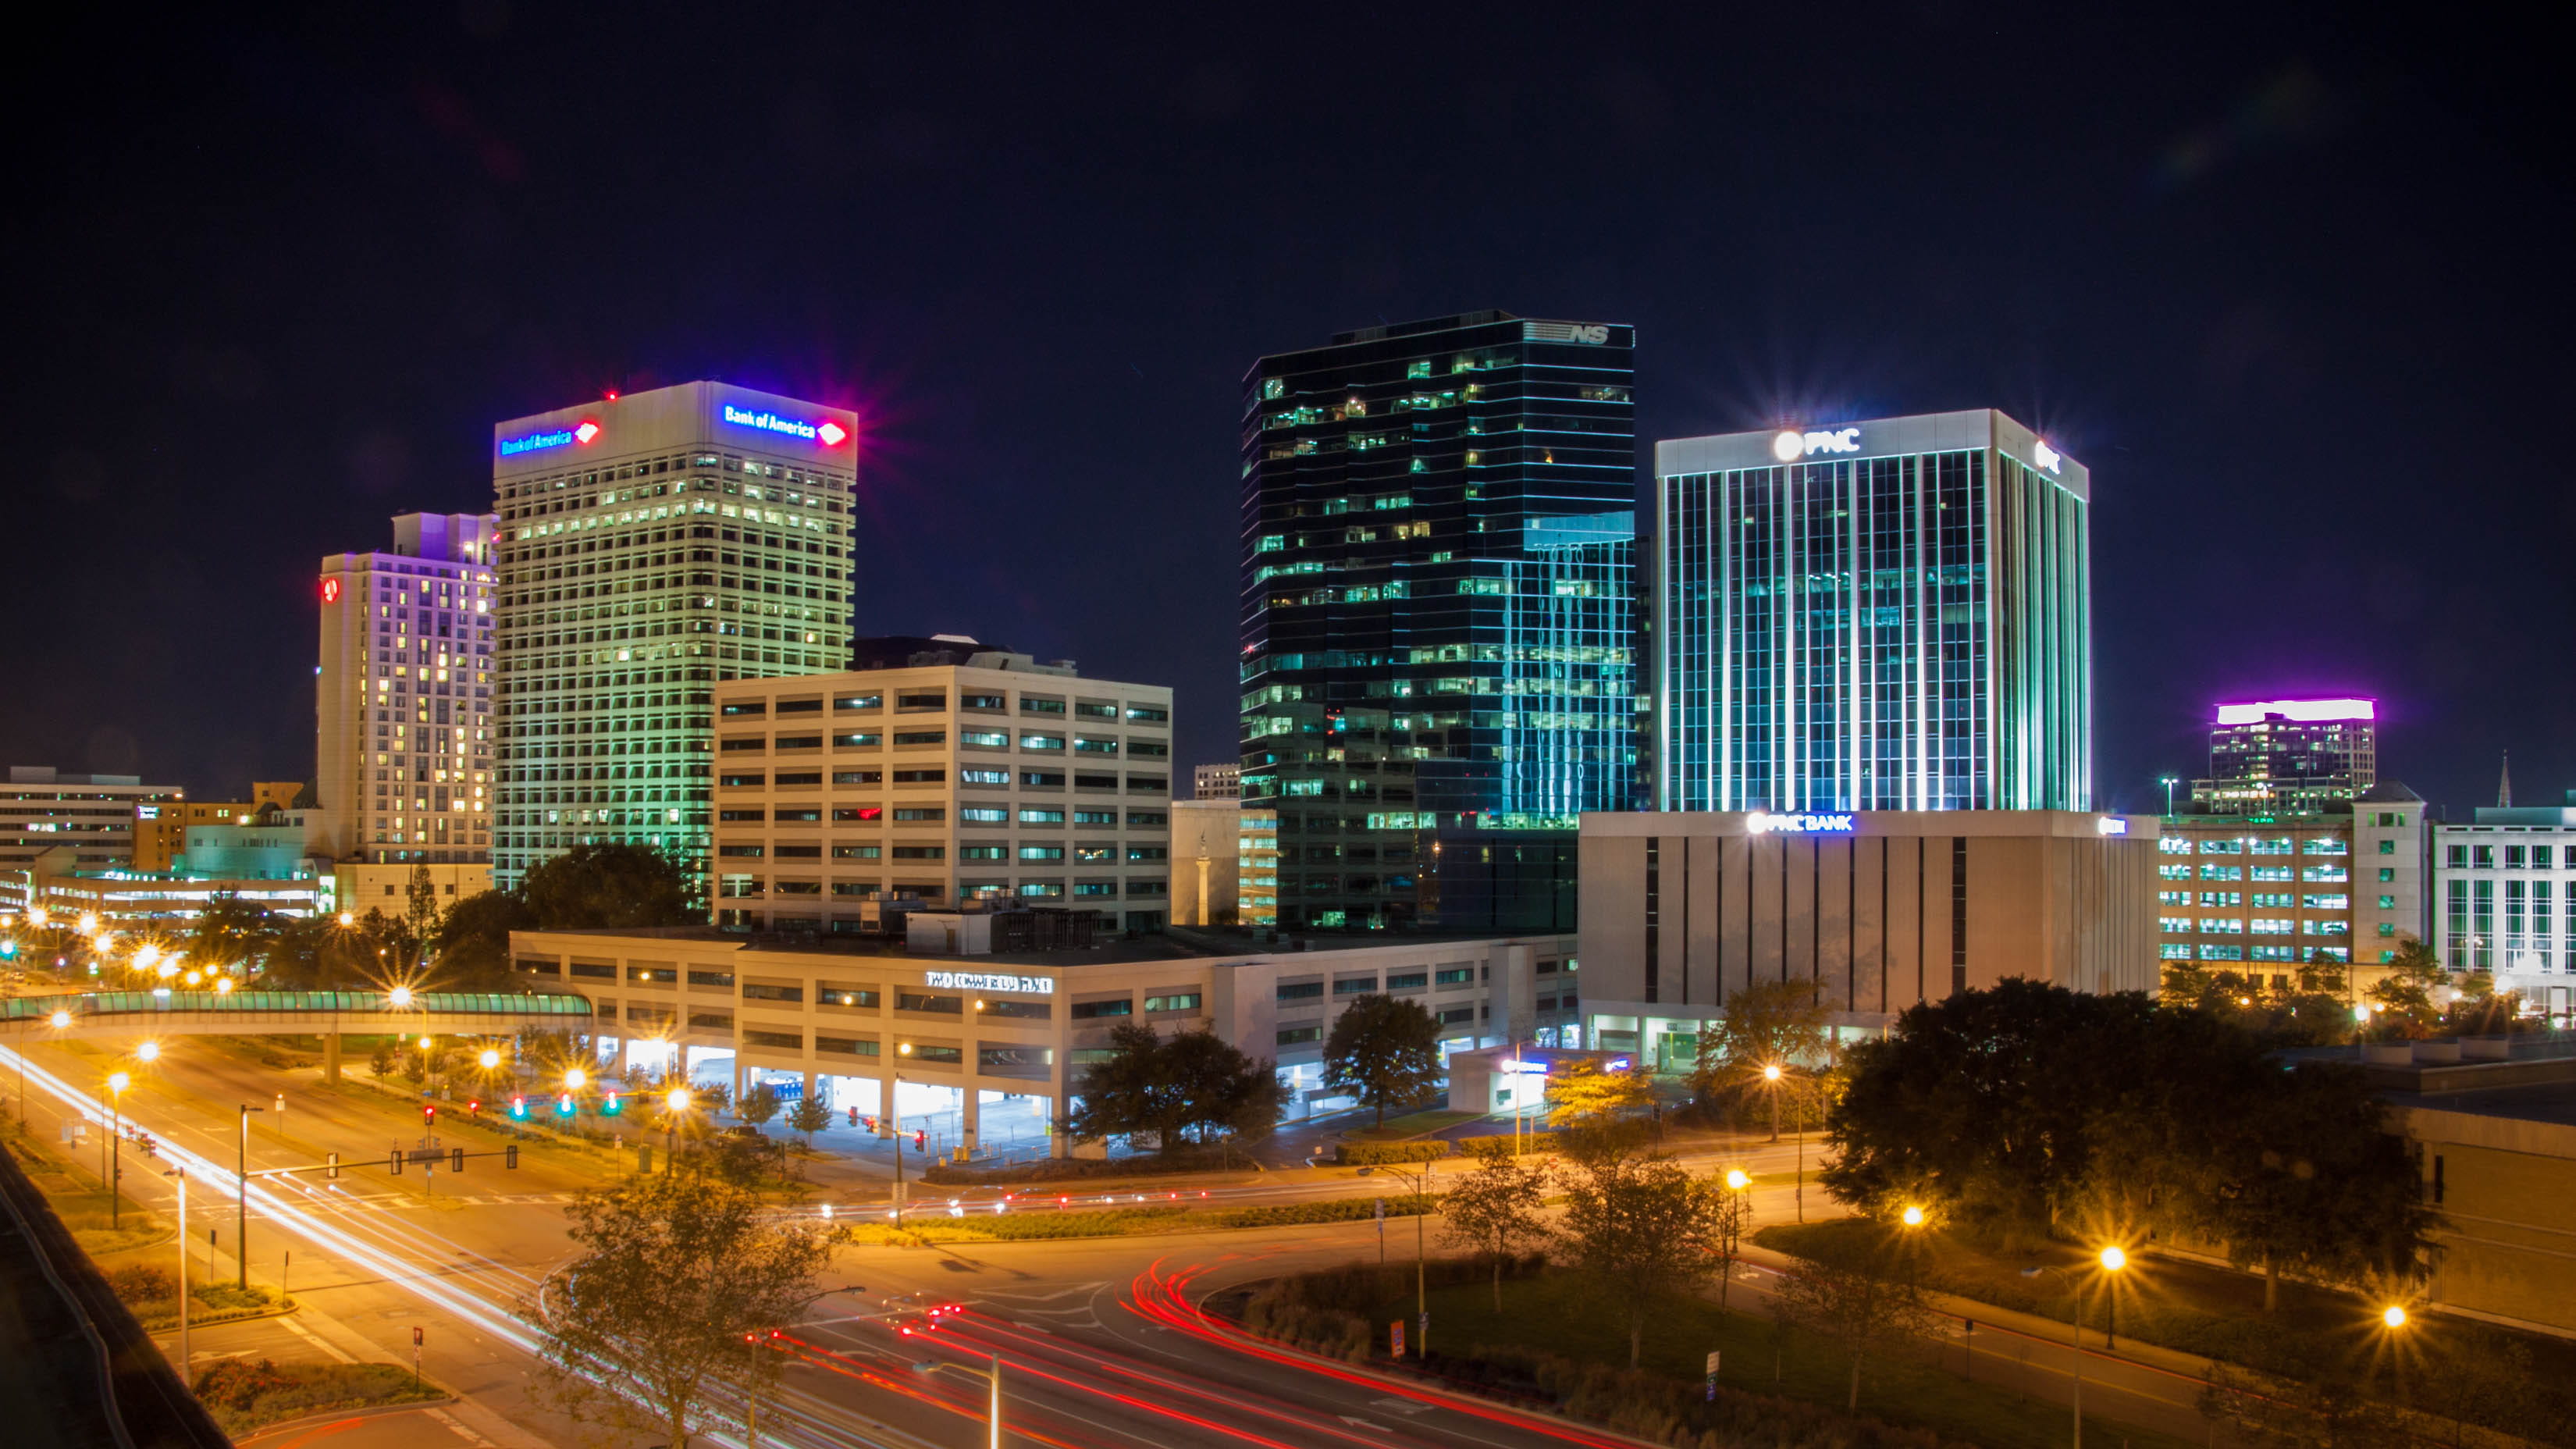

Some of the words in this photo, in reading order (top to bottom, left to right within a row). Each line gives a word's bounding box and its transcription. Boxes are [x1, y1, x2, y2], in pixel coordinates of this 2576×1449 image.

[1568, 325, 1610, 344] NS
[724, 405, 755, 426] Bank
[756, 413, 768, 429] of
[768, 415, 816, 439] America
[501, 438, 524, 455] Bank
[524, 435, 535, 451] of
[534, 430, 571, 450] America
[1804, 428, 1860, 455] PNC
[1805, 815, 1852, 831] BANK
